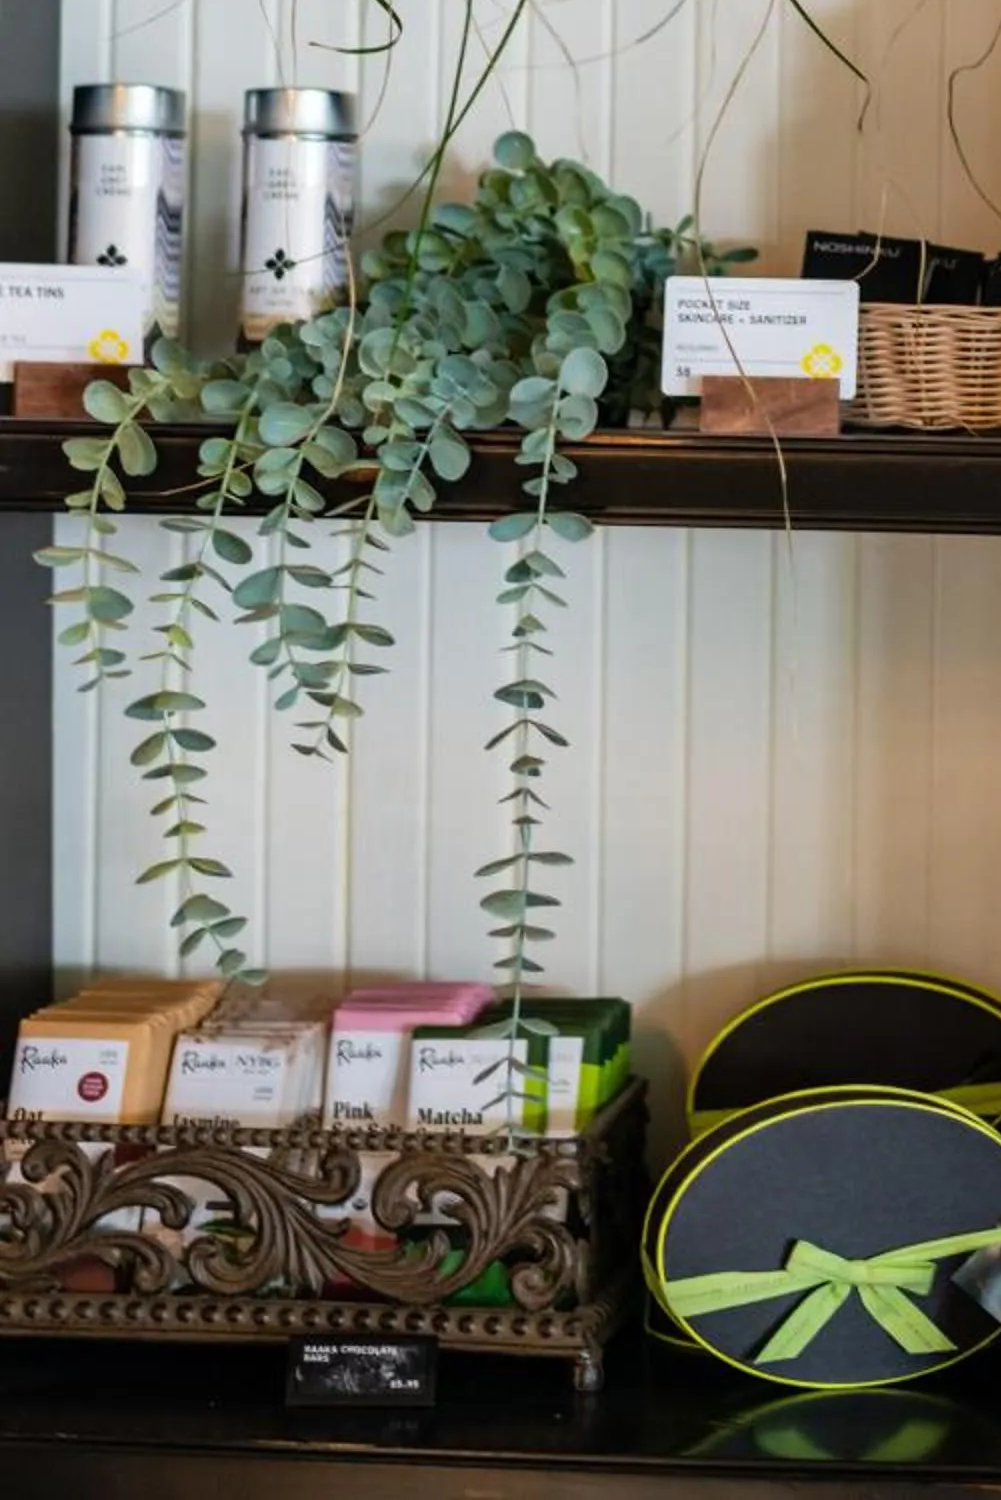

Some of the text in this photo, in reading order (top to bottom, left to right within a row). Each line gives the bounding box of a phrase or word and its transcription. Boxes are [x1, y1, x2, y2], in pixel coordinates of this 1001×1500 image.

[9, 285, 32, 298] TEA
[36, 286, 64, 299] TINS
[677, 299, 751, 311] POCKET SIZE
[677, 312, 734, 324] SKINCARE
[749, 314, 807, 325] SANITIZER
[21, 1046, 68, 1074] Raaka
[336, 1040, 383, 1066] Raaka
[418, 1047, 464, 1072] Raaka
[333, 1101, 374, 1119] Pink
[417, 1107, 483, 1125] Matcha
